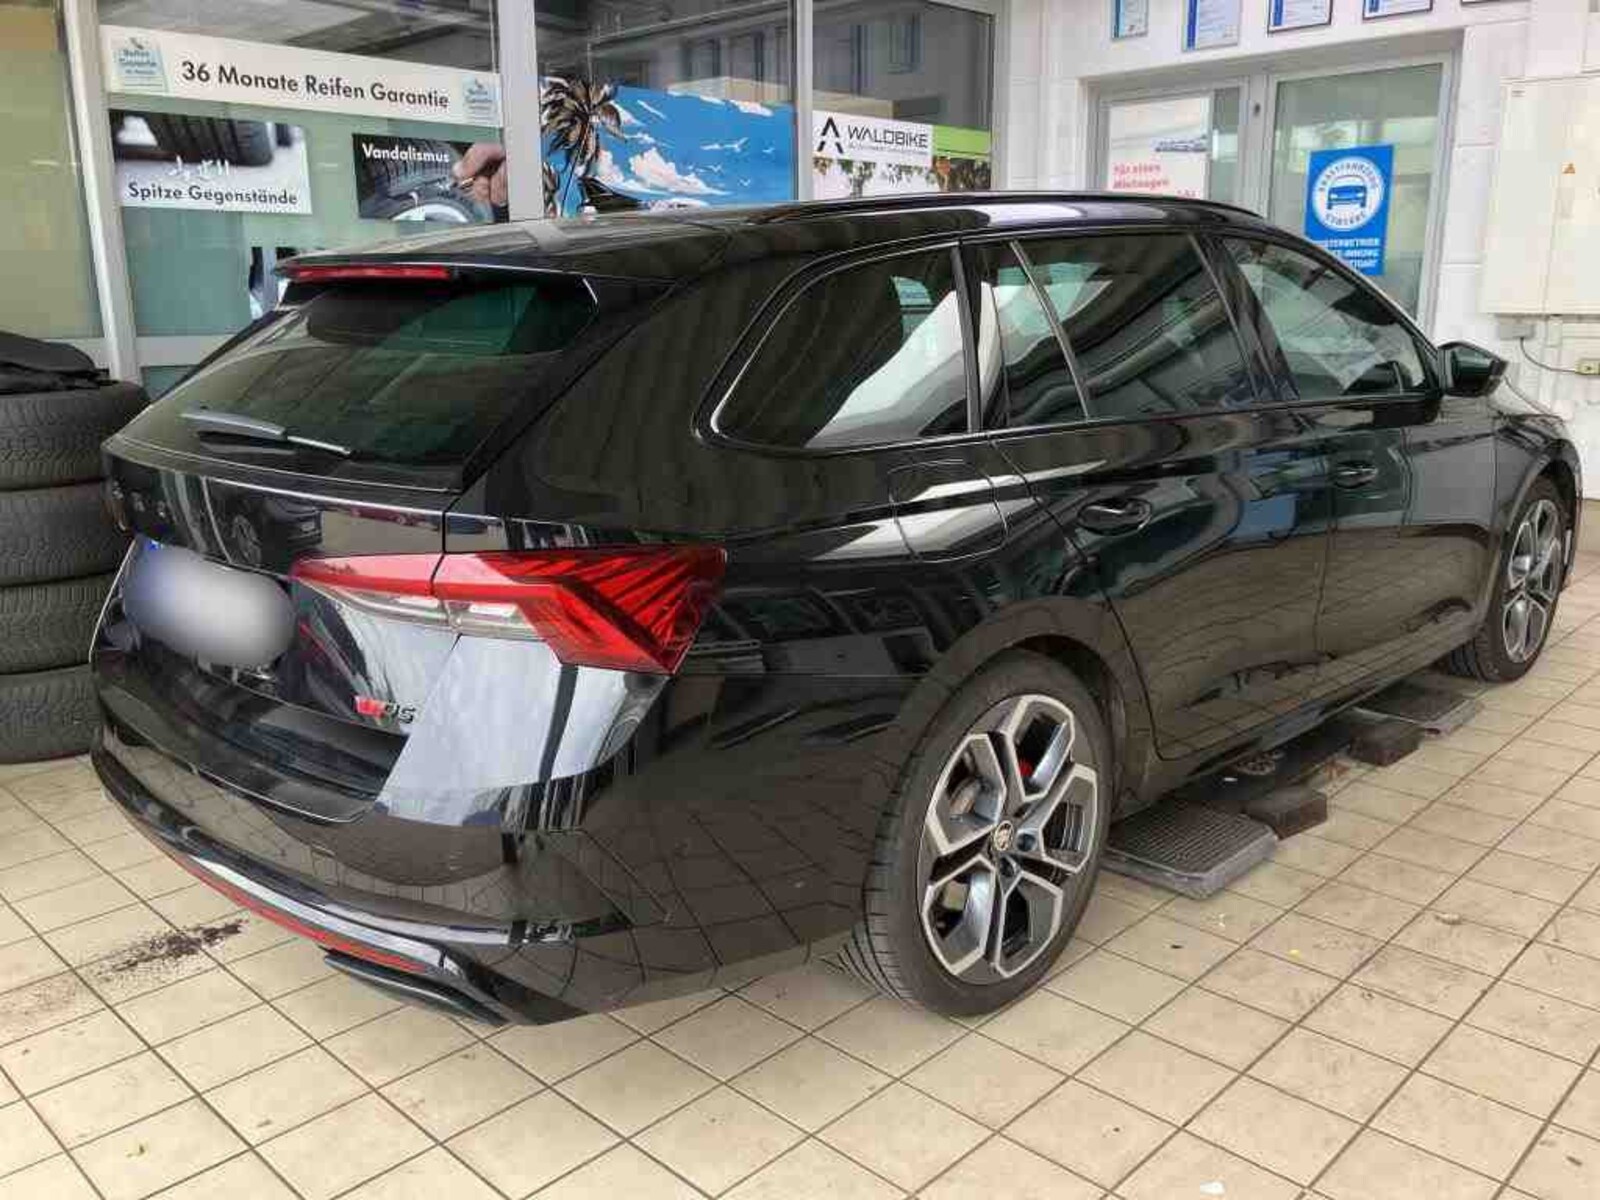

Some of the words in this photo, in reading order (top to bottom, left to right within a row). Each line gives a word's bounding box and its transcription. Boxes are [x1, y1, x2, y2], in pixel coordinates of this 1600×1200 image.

[181, 59, 211, 84] 36
[217, 66, 299, 93] Monate
[305, 75, 365, 101] Reifen
[370, 83, 450, 109] Garantie
[847, 124, 928, 149] WALDBIKE
[362, 141, 451, 164] Vandalismus
[128, 182, 183, 202] Spitze
[188, 185, 298, 206] Gegenstände
